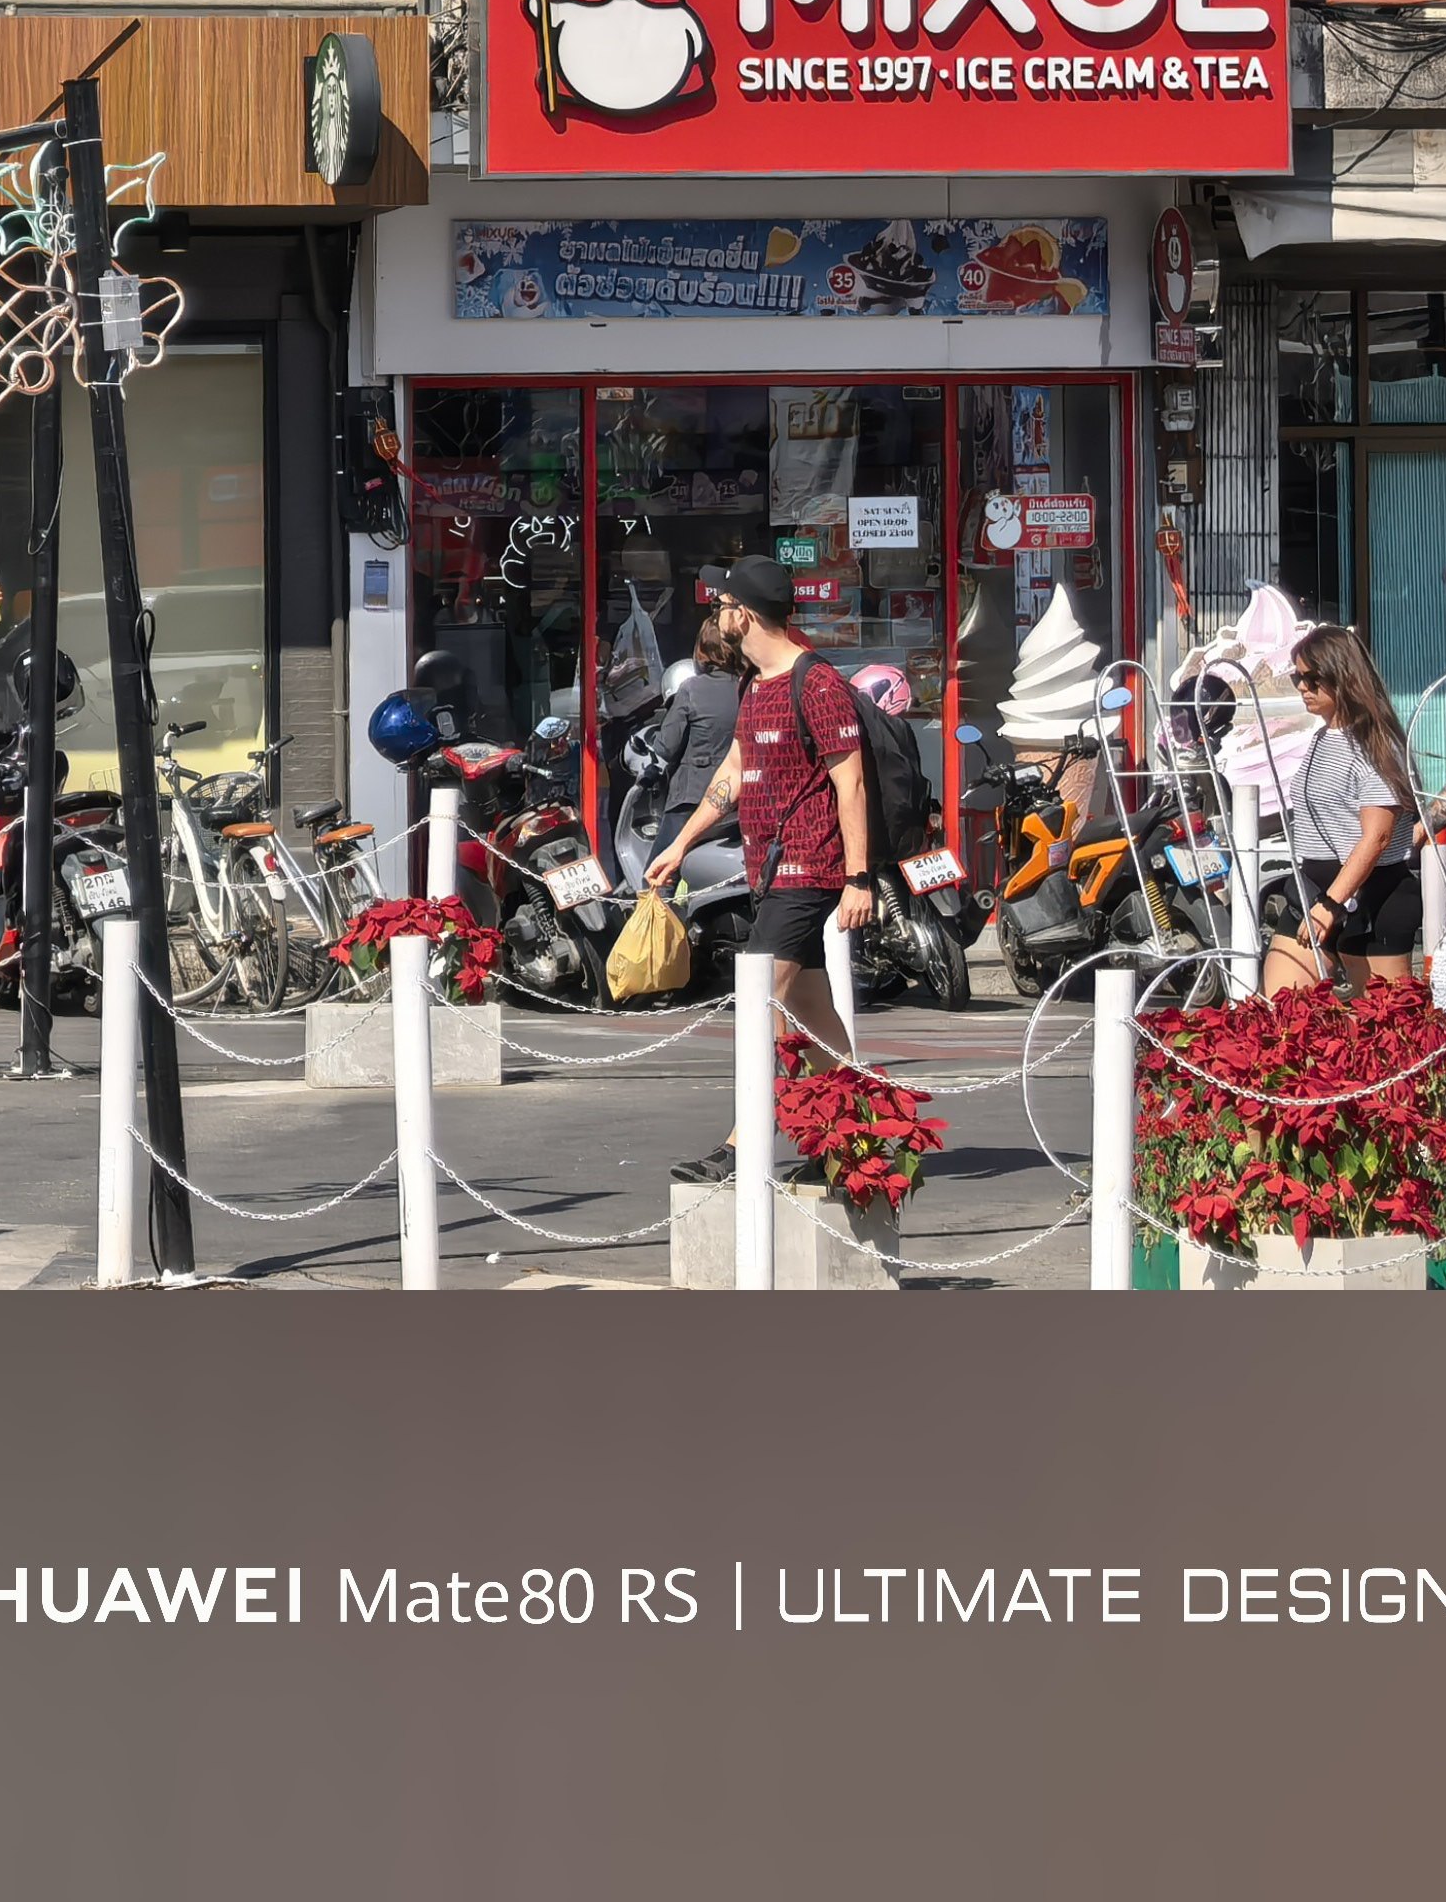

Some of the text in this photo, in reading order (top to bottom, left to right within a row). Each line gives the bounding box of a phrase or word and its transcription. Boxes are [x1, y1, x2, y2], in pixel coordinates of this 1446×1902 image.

[738, 56, 1270, 93] SINCE 1997 ICE CREAM & TEA
[776, 863, 805, 877] FEEL
